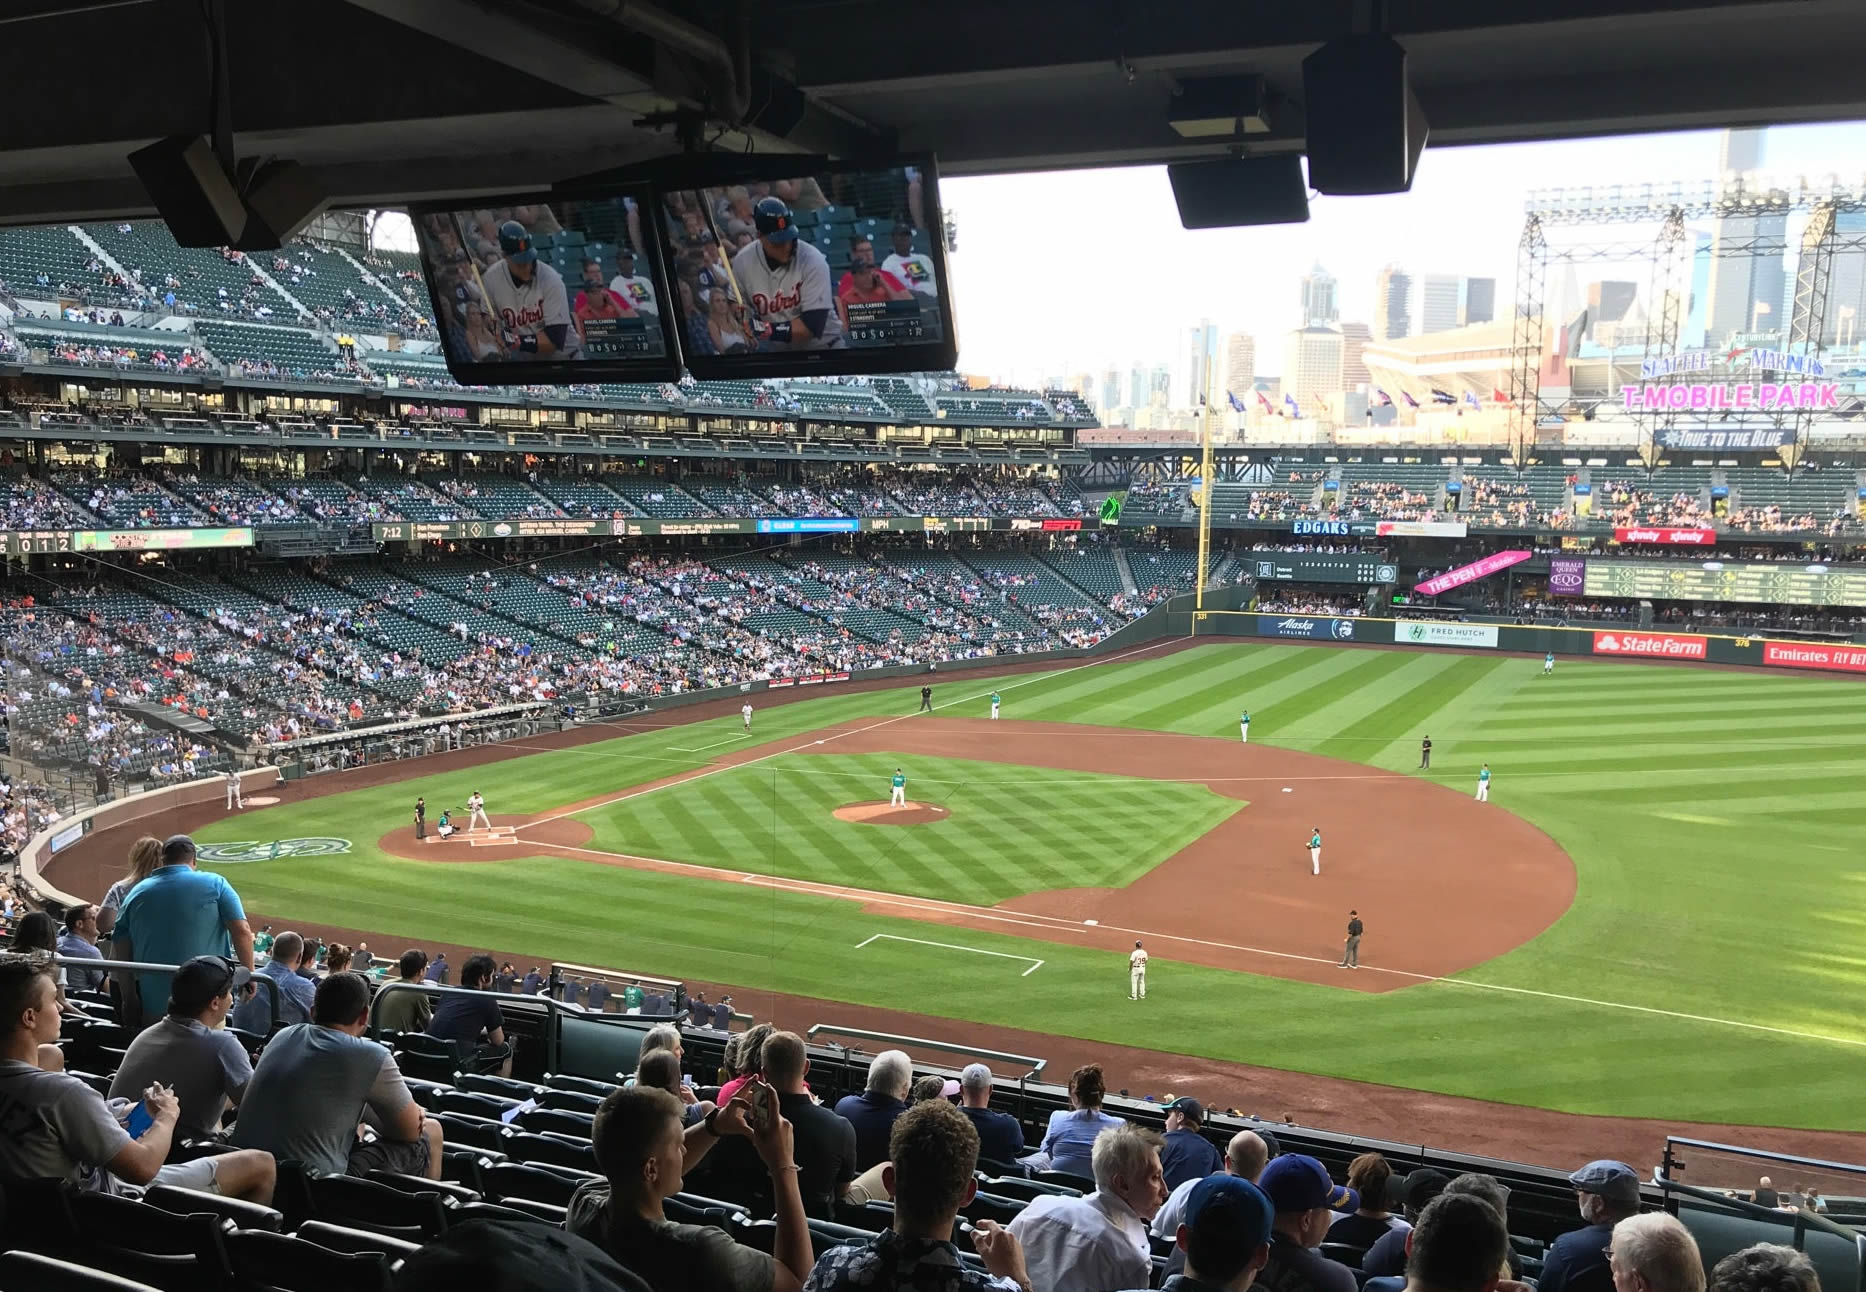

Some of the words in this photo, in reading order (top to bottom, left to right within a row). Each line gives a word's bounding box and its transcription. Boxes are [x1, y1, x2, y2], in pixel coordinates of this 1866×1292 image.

[752, 280, 803, 316] Detroit
[502, 299, 545, 328] Detroit
[1751, 348, 1824, 376] MARINERS
[1621, 385, 1753, 408] T-MOBILE
[1758, 383, 1840, 408] PARK
[1679, 430, 1710, 447] TRUE
[1710, 432, 1726, 447] TO
[1727, 431, 1751, 447] THE
[1751, 430, 1784, 447] BLUE
[872, 520, 889, 529] MPH
[1043, 520, 1082, 530] ESPN
[382, 527, 402, 538] 7:12
[1627, 530, 1660, 542] xfinity
[1670, 531, 1704, 543] xfinity
[22, 539, 31, 552] 0
[41, 539, 48, 551] 1
[59, 538, 69, 551] 2
[1427, 577, 1451, 593] THE
[1554, 575, 1582, 587] EQC
[1277, 618, 1314, 631] Alaska
[1431, 627, 1453, 635] FRED
[1769, 647, 1829, 662] Emirates
[1833, 652, 1849, 664] FLY
[1137, 957, 1146, 965] 39
